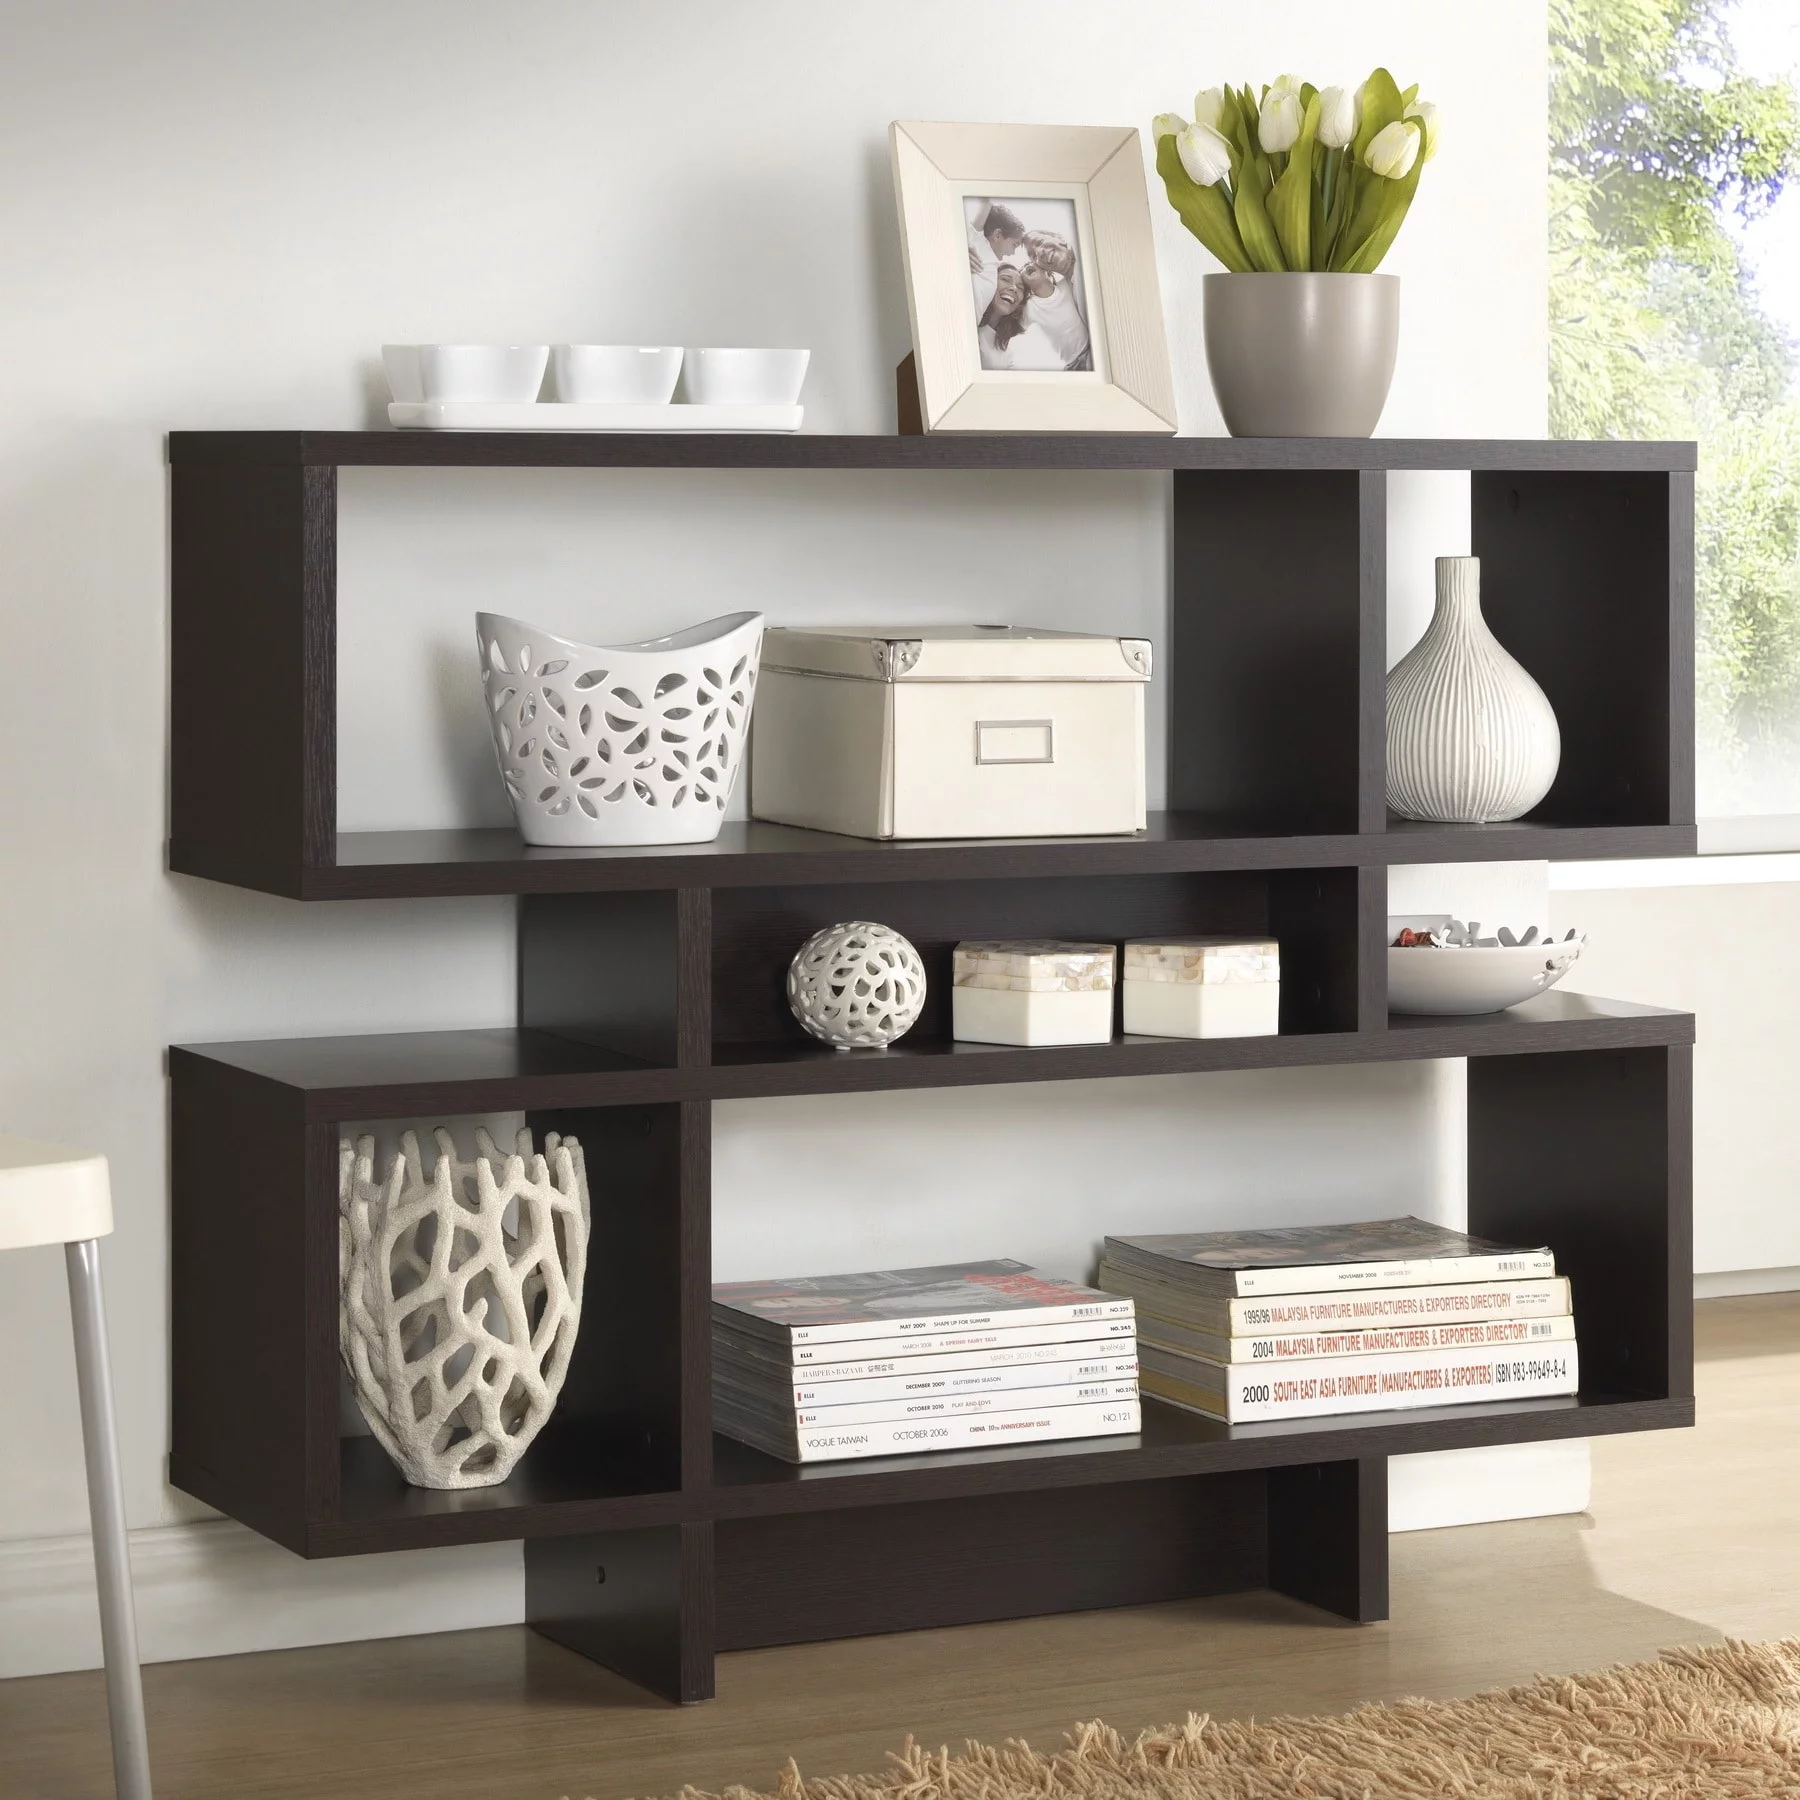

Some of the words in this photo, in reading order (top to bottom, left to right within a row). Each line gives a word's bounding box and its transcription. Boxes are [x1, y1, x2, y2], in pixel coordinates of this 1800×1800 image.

[1244, 1309, 1270, 1324] 1995/96
[1271, 1306, 1309, 1322] MALAYSIA
[1310, 1303, 1351, 1320] FURNITURE
[1353, 1298, 1418, 1317] MANUFACTURERS
[1419, 1300, 1425, 1312] &
[1426, 1296, 1469, 1312] EXPORTERS
[1471, 1293, 1512, 1310] DIRECTORY
[1253, 1342, 1274, 1358] 2004
[1276, 1338, 1314, 1356] MALAYSIA
[1317, 1335, 1360, 1353] FURNITURE
[1362, 1330, 1430, 1350] MANUFACTURERS
[1432, 1330, 1438, 1345] &
[1440, 1325, 1485, 1344] EXPORTERS
[1486, 1323, 1528, 1341] DIRECTORY
[1243, 1384, 1269, 1403] 2000
[1274, 1381, 1298, 1402] SOUTH
[1300, 1378, 1317, 1399] EAST
[1319, 1377, 1335, 1398] ASIA
[1338, 1374, 1377, 1395] FURNITURE
[1379, 1369, 1442, 1395] (MANUFACTURERS
[1444, 1368, 1450, 1388] &
[1452, 1362, 1494, 1387] EXPORTERS)
[1496, 1363, 1511, 1383] ISBN
[1513, 1359, 1566, 1381] 983-99649-8-4
[1103, 1412, 1131, 1422] NO.121
[1000, 1422, 1034, 1430] ANNIVERSARY
[892, 1431, 928, 1441] OCTOBER
[930, 1428, 948, 1437] 2006
[806, 1438, 835, 1448] VOGUE
[837, 1435, 868, 1446] TAIWAN
